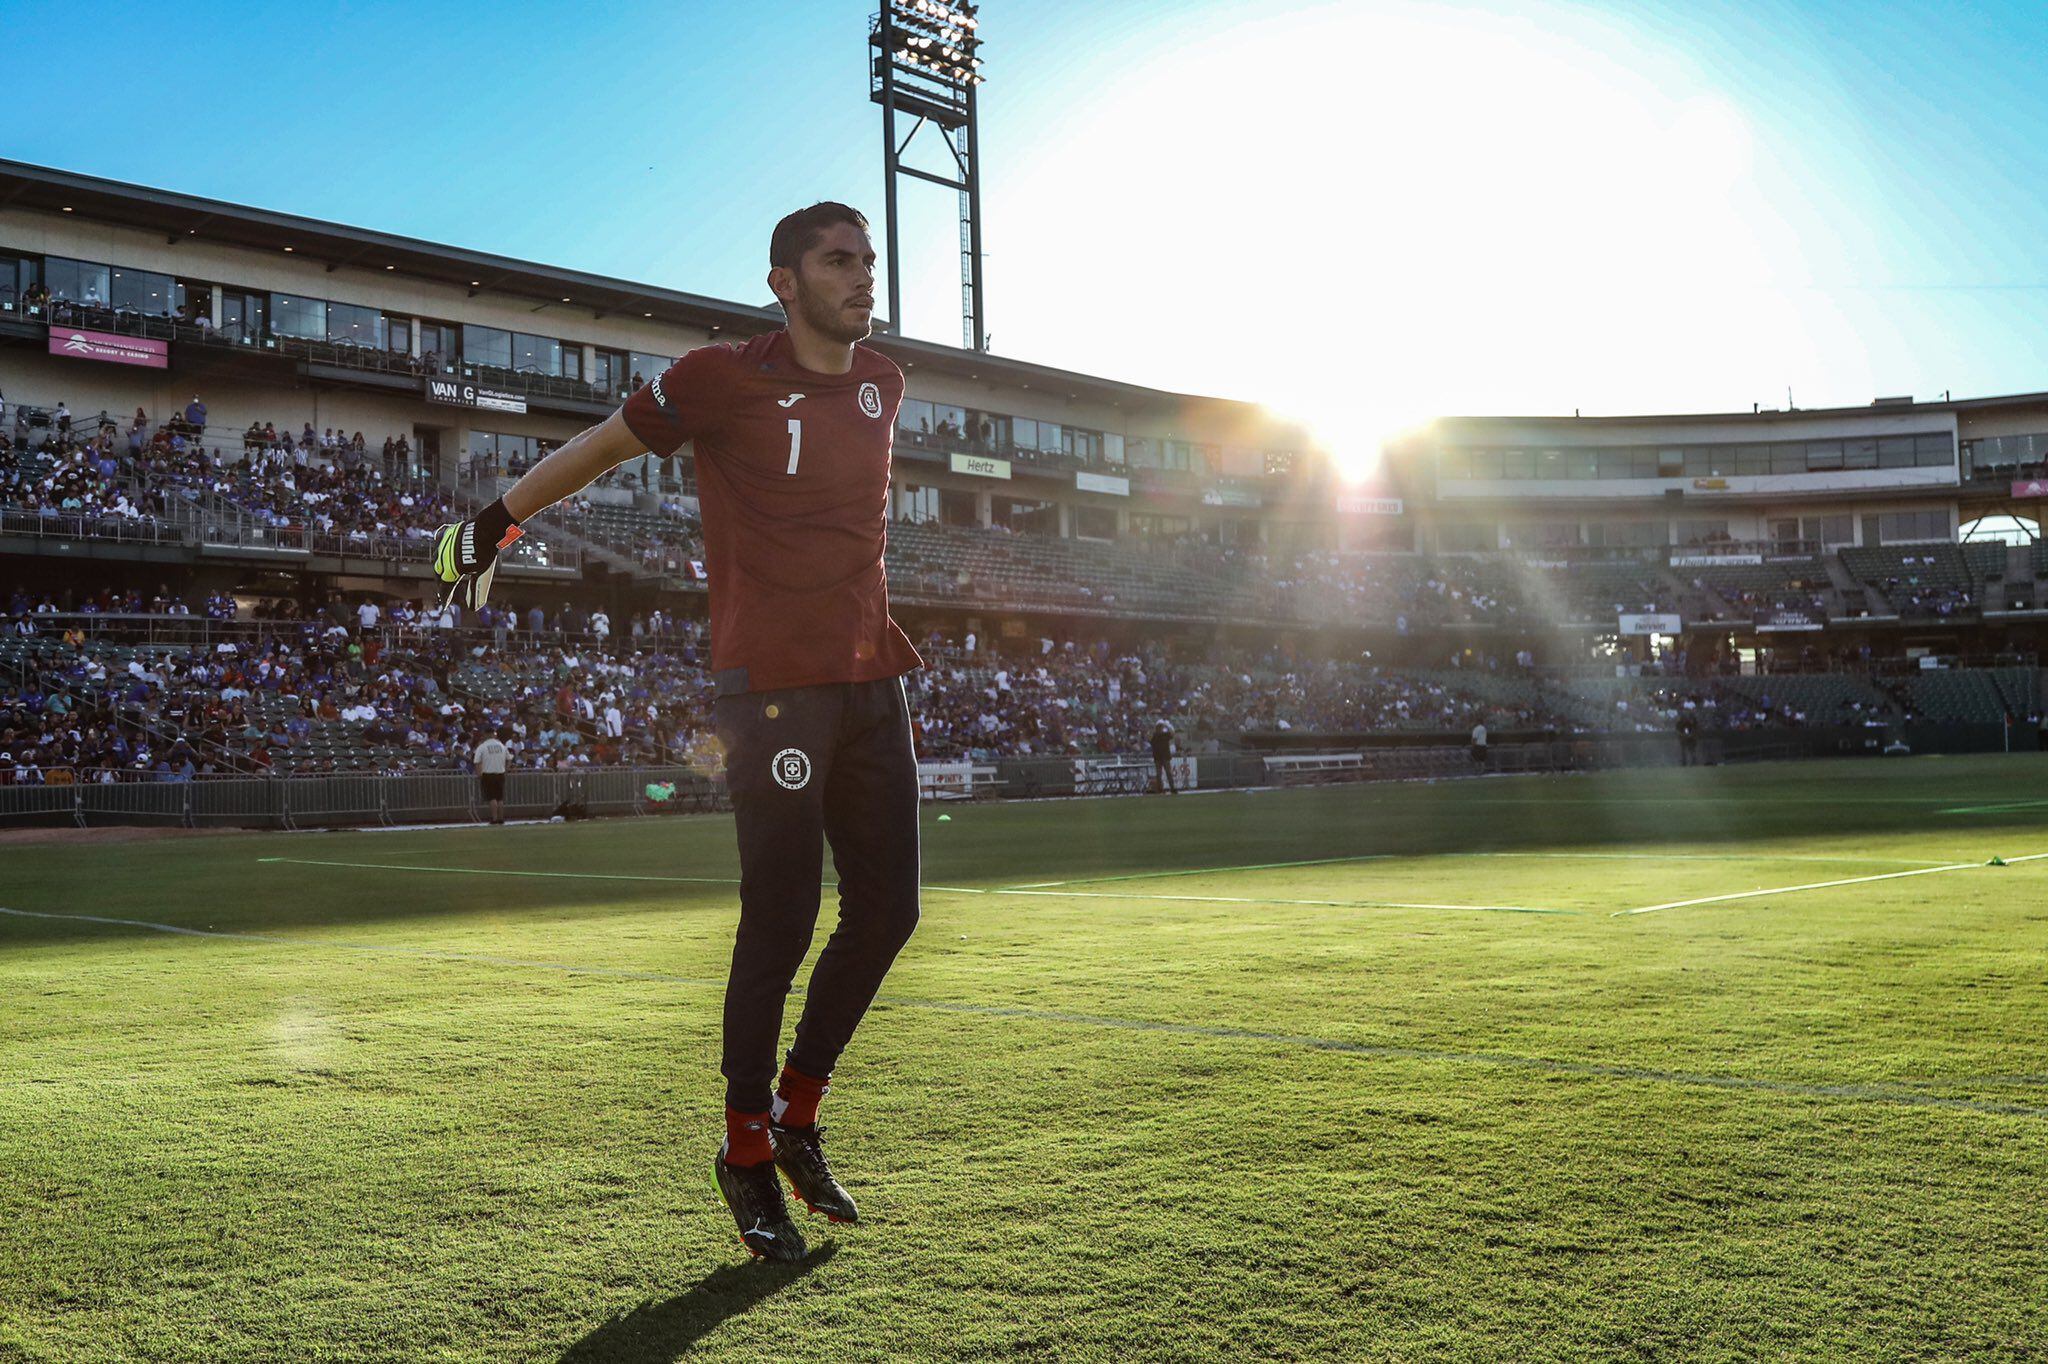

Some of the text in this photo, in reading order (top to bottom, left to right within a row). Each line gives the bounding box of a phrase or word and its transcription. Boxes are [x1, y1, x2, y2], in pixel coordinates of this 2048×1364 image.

[431, 381, 474, 399] VAN G
[786, 419, 801, 475] 1
[967, 459, 995, 473] Hertz
